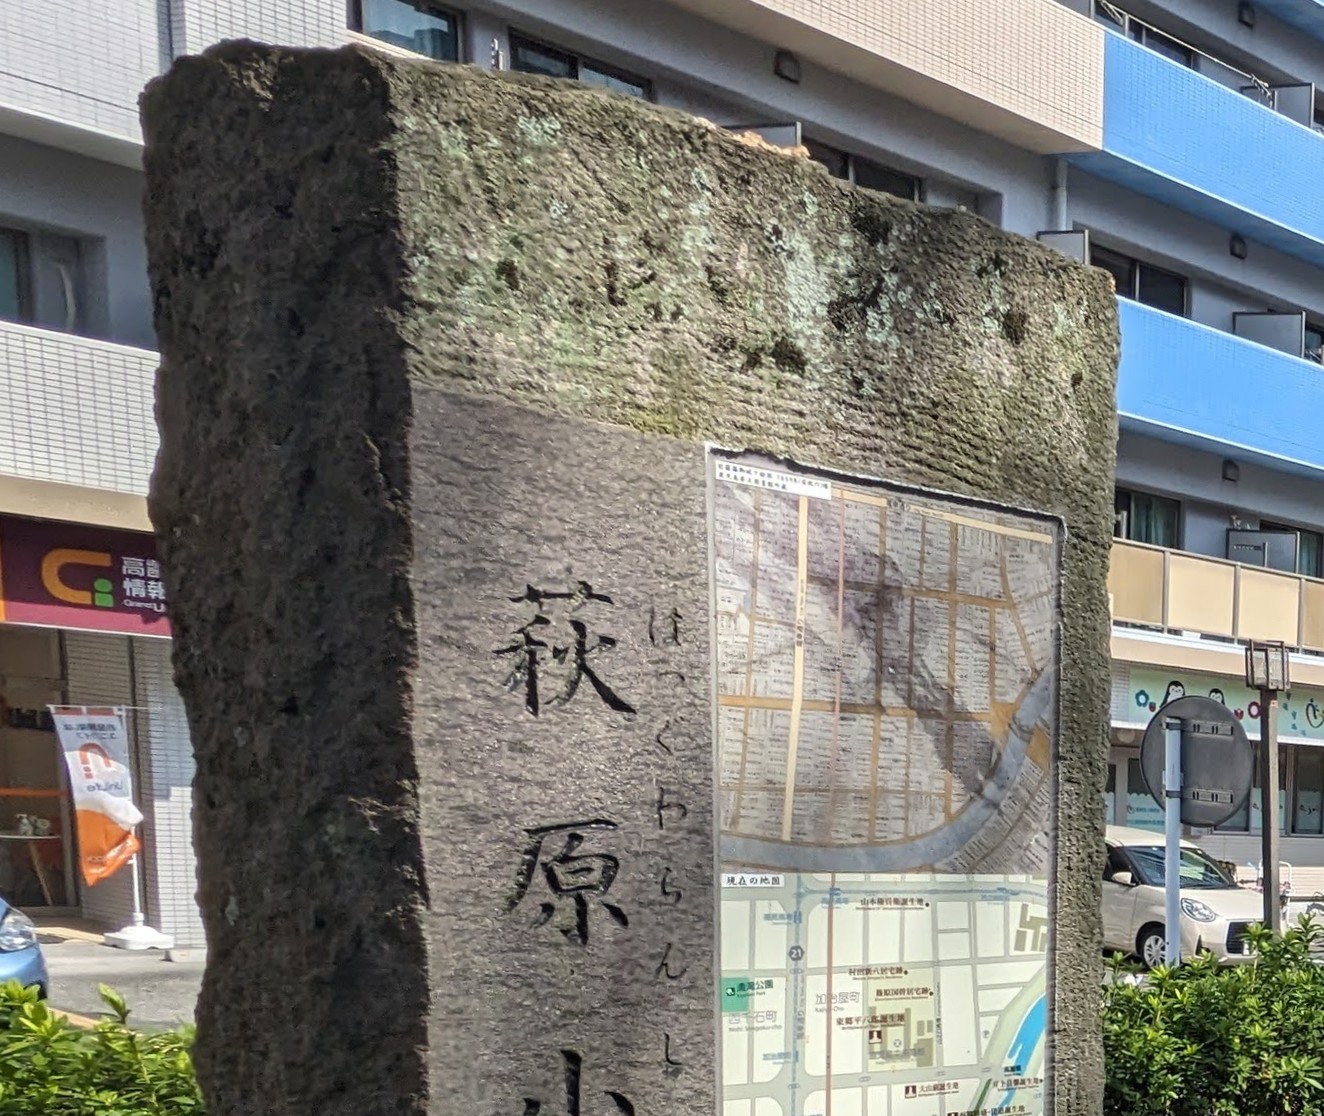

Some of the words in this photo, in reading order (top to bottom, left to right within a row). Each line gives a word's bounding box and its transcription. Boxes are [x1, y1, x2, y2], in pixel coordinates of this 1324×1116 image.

[726, 875, 781, 886] 現在の地図
